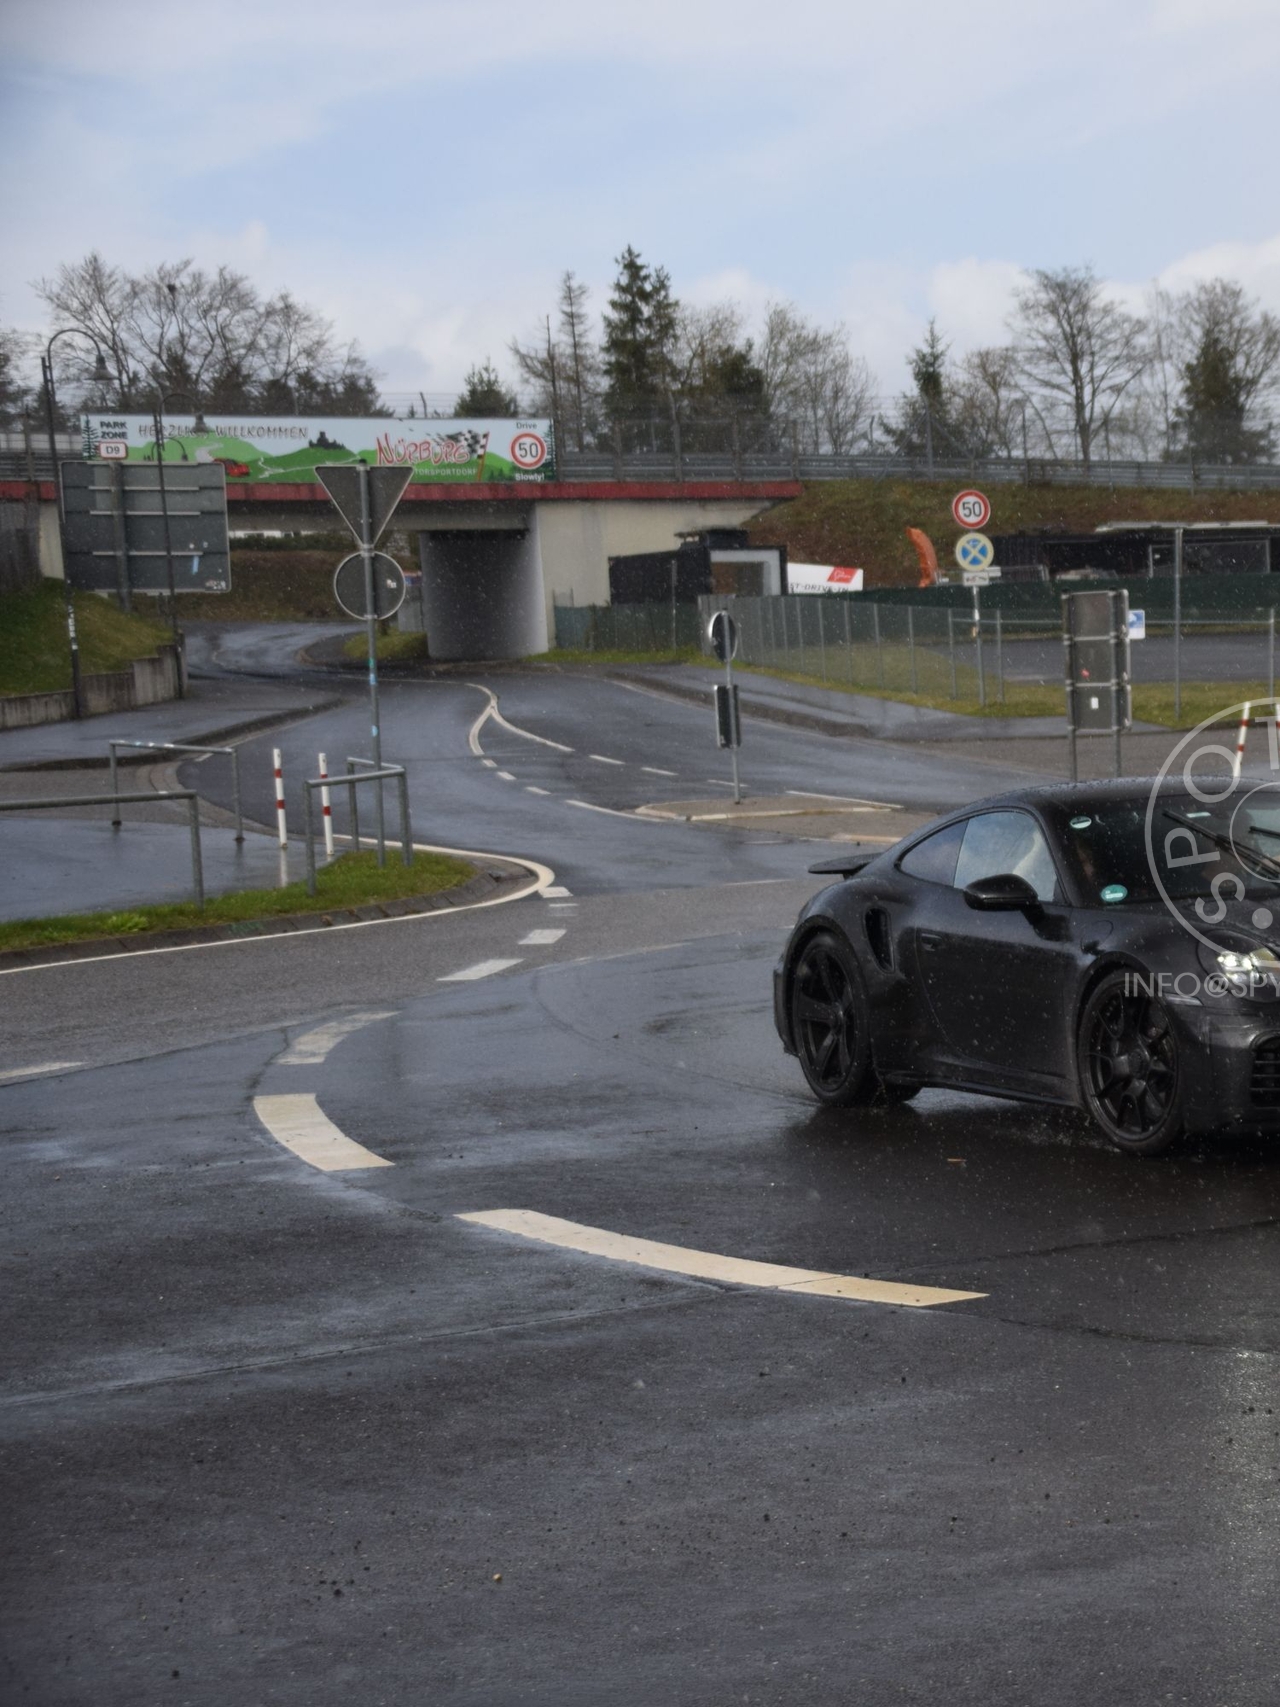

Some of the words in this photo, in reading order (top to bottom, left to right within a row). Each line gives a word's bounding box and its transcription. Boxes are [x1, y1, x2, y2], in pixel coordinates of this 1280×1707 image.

[101, 421, 126, 430] PARK
[516, 421, 537, 430] Drive
[101, 431, 127, 439] ZONE
[215, 424, 309, 438] WILLKOMMEN
[106, 445, 120, 454] D9
[518, 442, 539, 458] 50
[962, 501, 982, 518] 50
